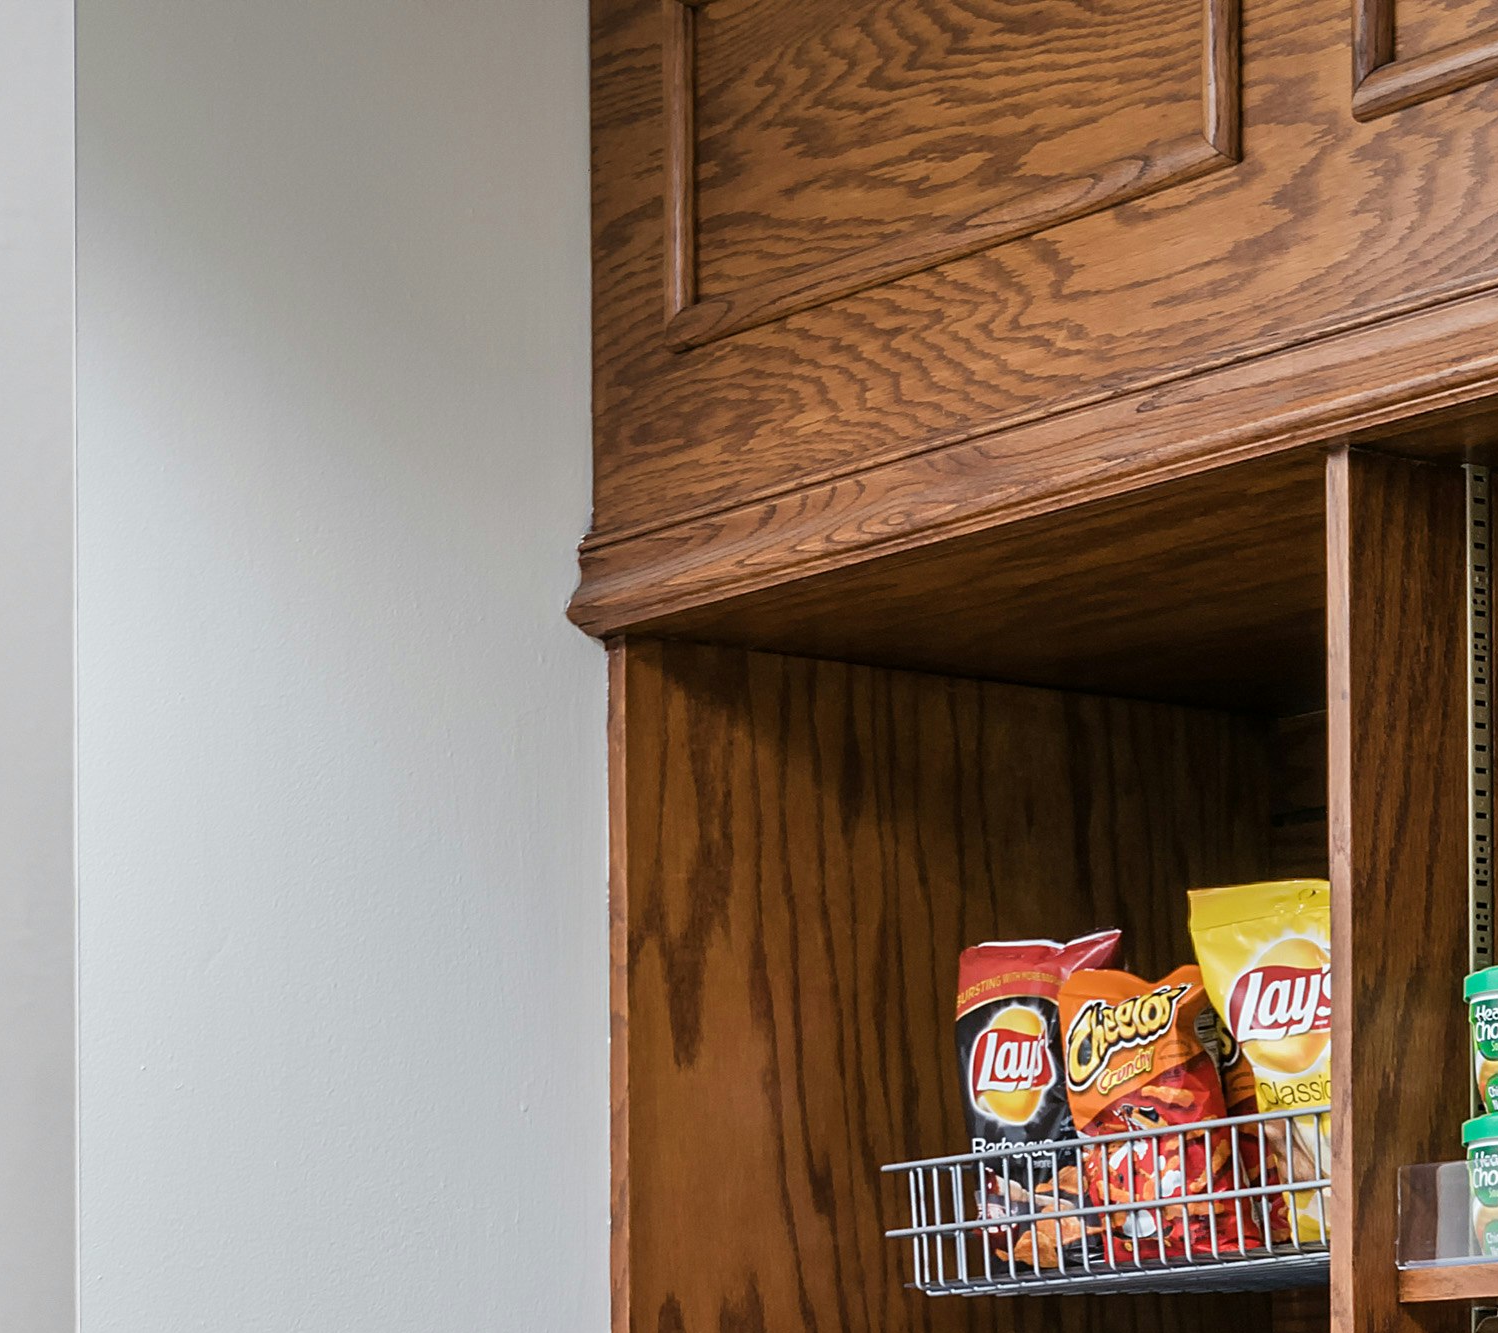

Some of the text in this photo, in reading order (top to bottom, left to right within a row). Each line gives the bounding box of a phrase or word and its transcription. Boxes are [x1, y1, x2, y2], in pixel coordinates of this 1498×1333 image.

[977, 1032, 1044, 1092] Lay's
[1067, 984, 1193, 1090] Cheetos
[1097, 1046, 1155, 1095] Crunchy
